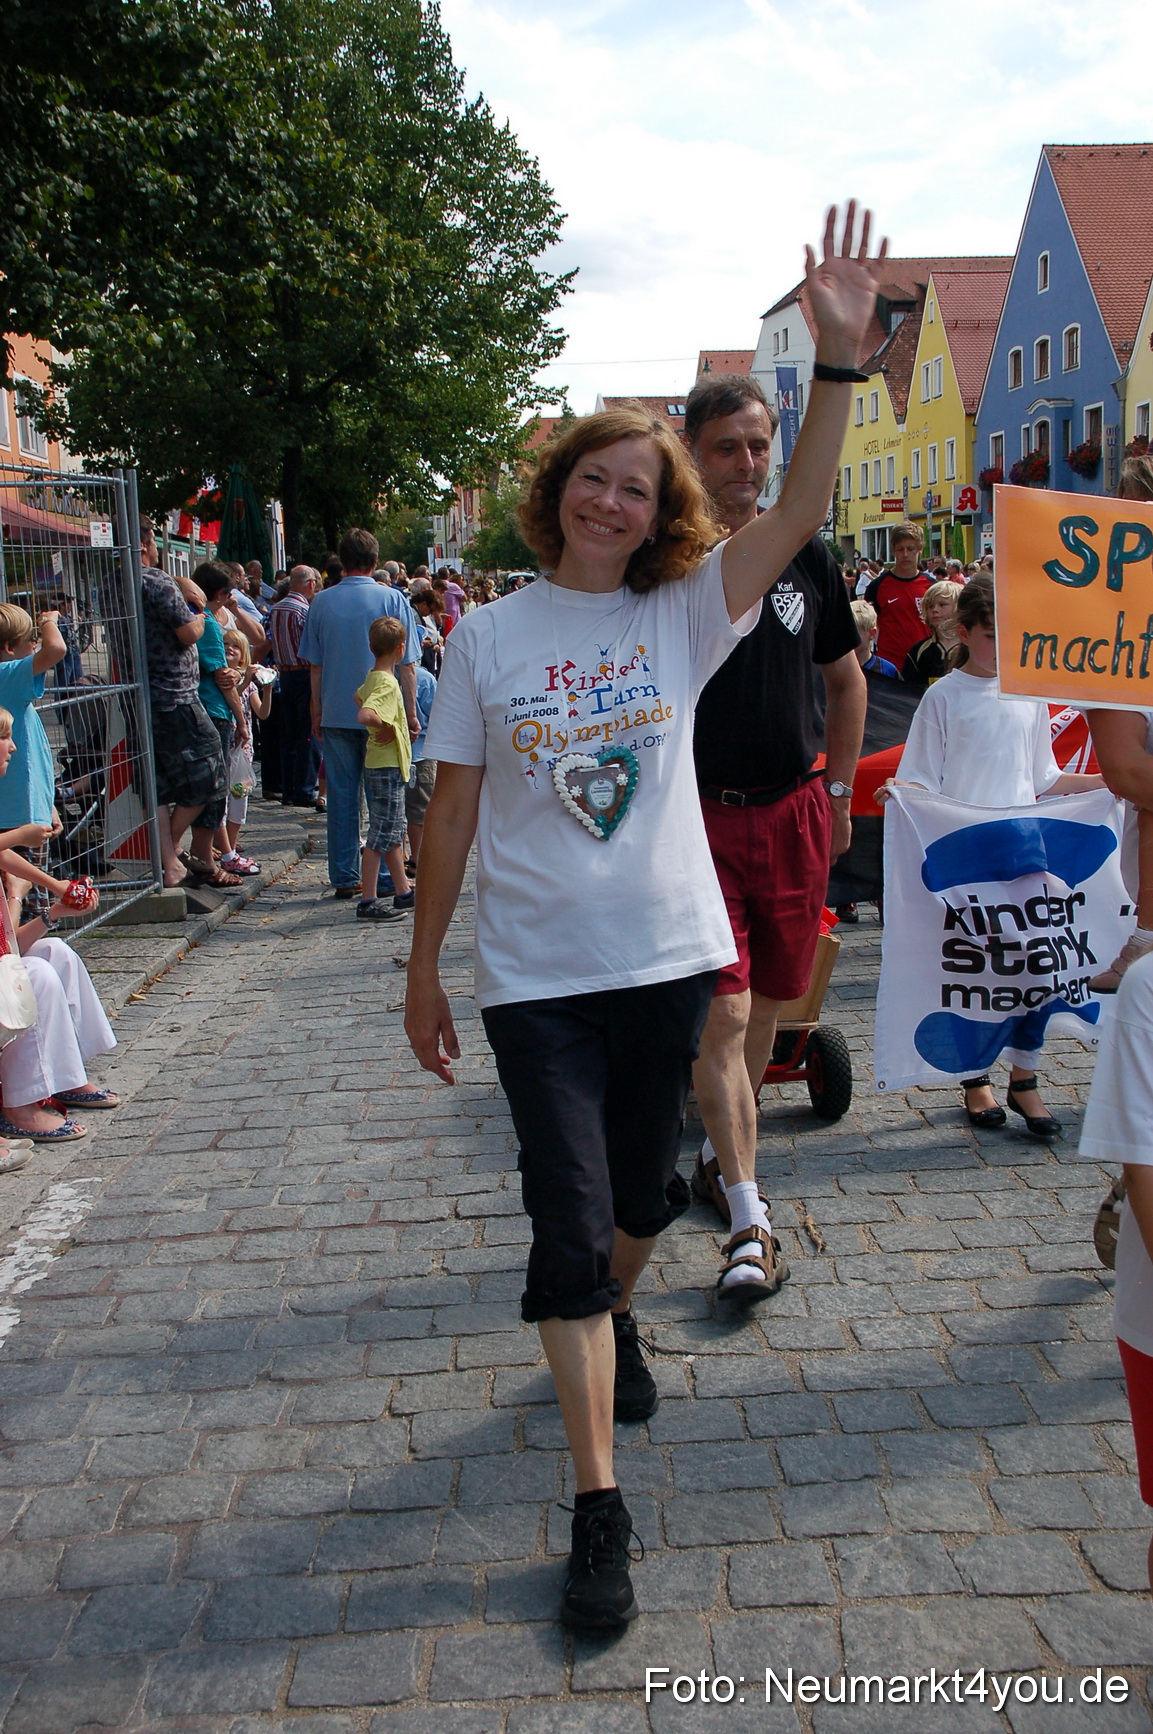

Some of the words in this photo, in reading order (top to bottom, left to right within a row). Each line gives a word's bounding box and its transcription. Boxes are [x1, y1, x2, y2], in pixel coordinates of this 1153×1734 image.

[863, 440, 880, 456] HOTEL
[863, 512, 886, 524] Restaurant
[1042, 515, 1153, 592] SP
[777, 581, 794, 592] Karl
[1020, 611, 1153, 679] macht
[510, 696, 529, 707] 30.
[530, 694, 548, 704] Mai
[532, 706, 560, 718] 2008
[512, 698, 674, 753] Olympiade
[942, 884, 1085, 937] kinder
[941, 927, 1097, 976] stark
